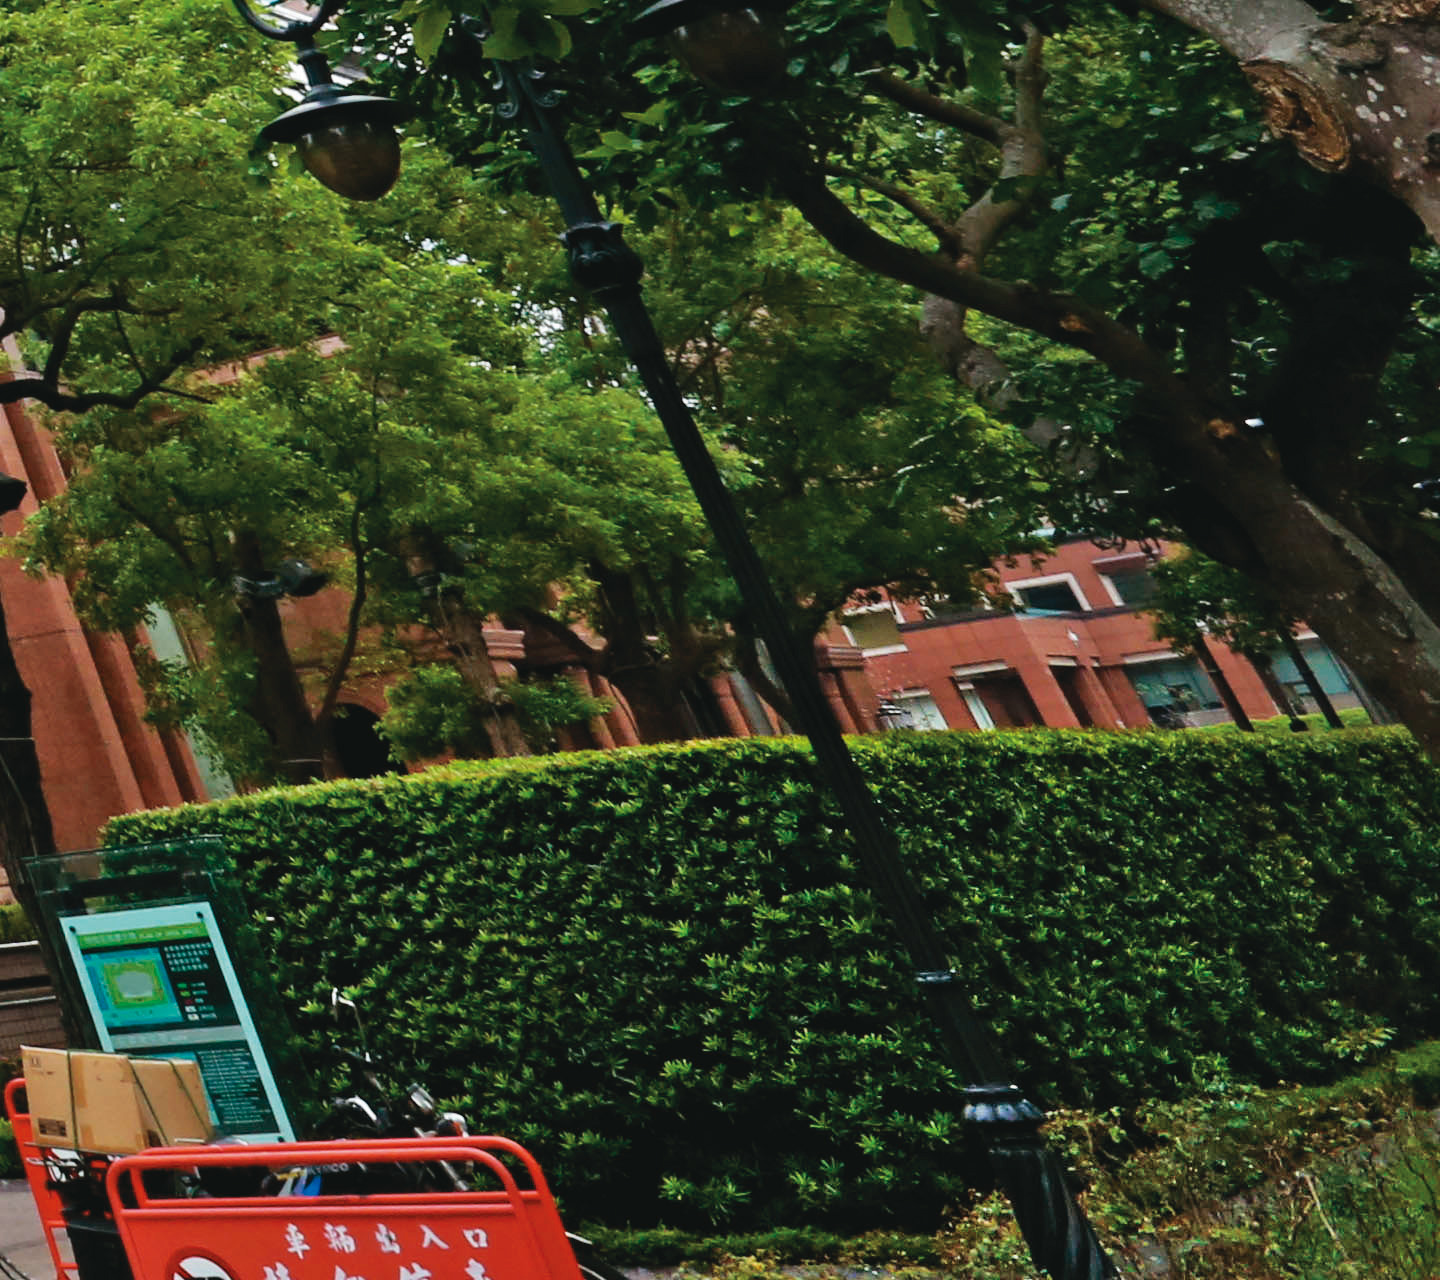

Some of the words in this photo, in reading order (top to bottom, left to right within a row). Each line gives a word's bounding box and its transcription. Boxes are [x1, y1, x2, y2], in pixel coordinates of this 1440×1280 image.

[284, 1222, 489, 1260] 車輛出入口
